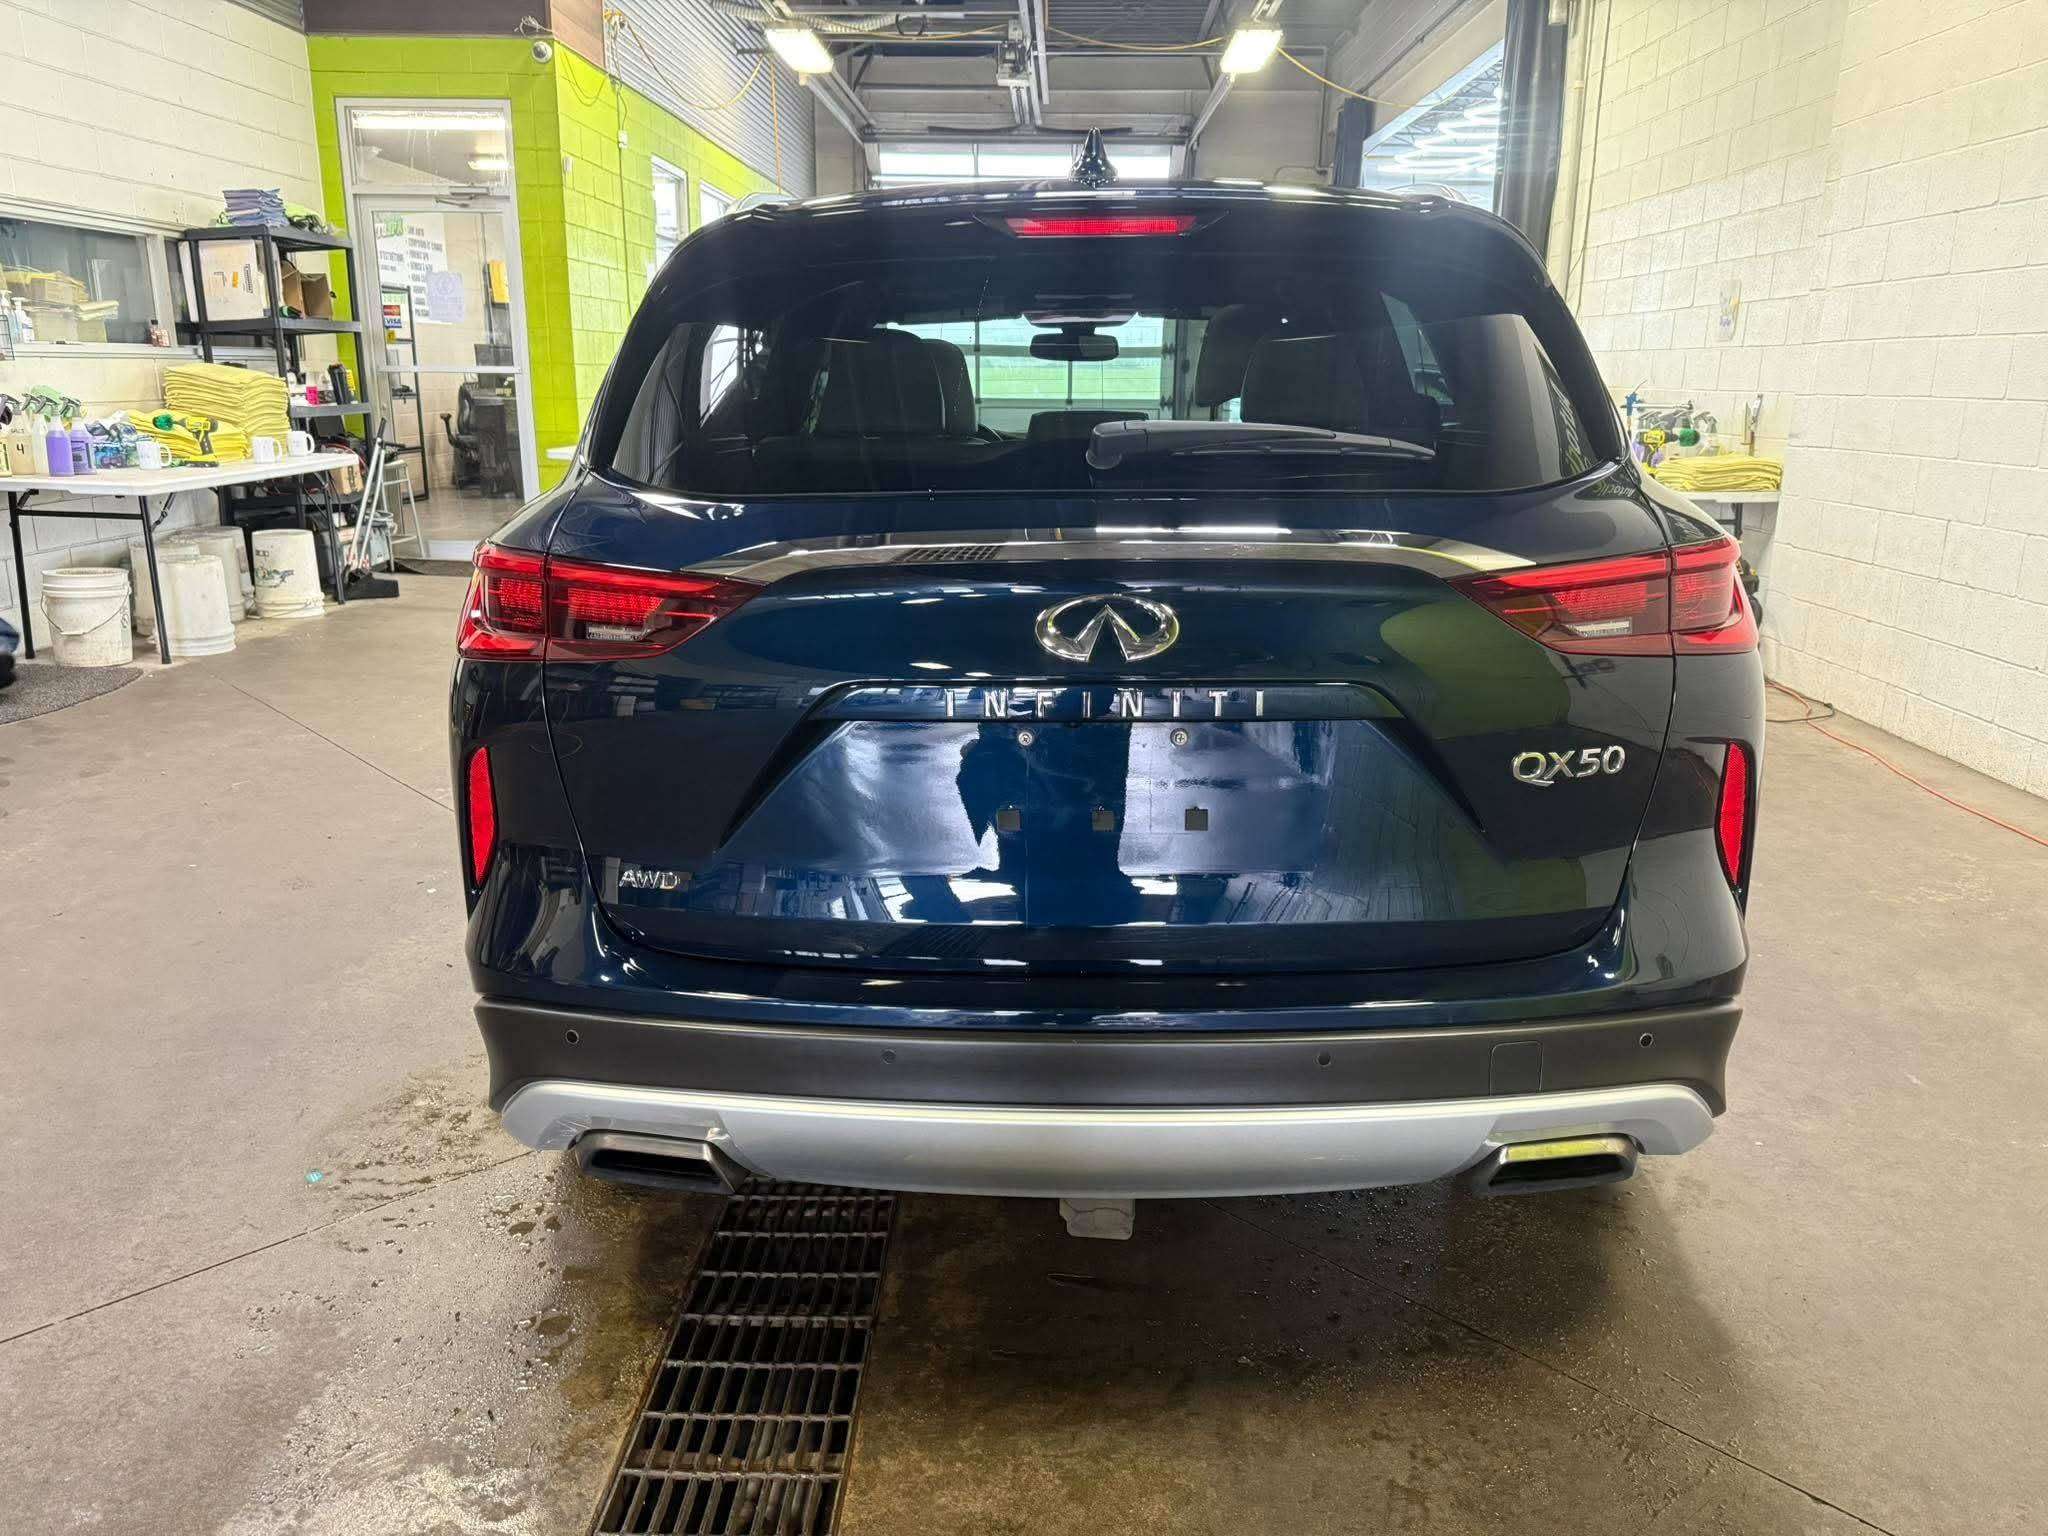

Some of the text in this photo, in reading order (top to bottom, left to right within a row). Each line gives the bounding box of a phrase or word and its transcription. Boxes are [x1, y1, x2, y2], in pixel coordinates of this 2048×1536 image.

[945, 689, 1266, 717] INFINITI
[1512, 745, 1626, 787] QX50
[618, 868, 681, 890] AWD
